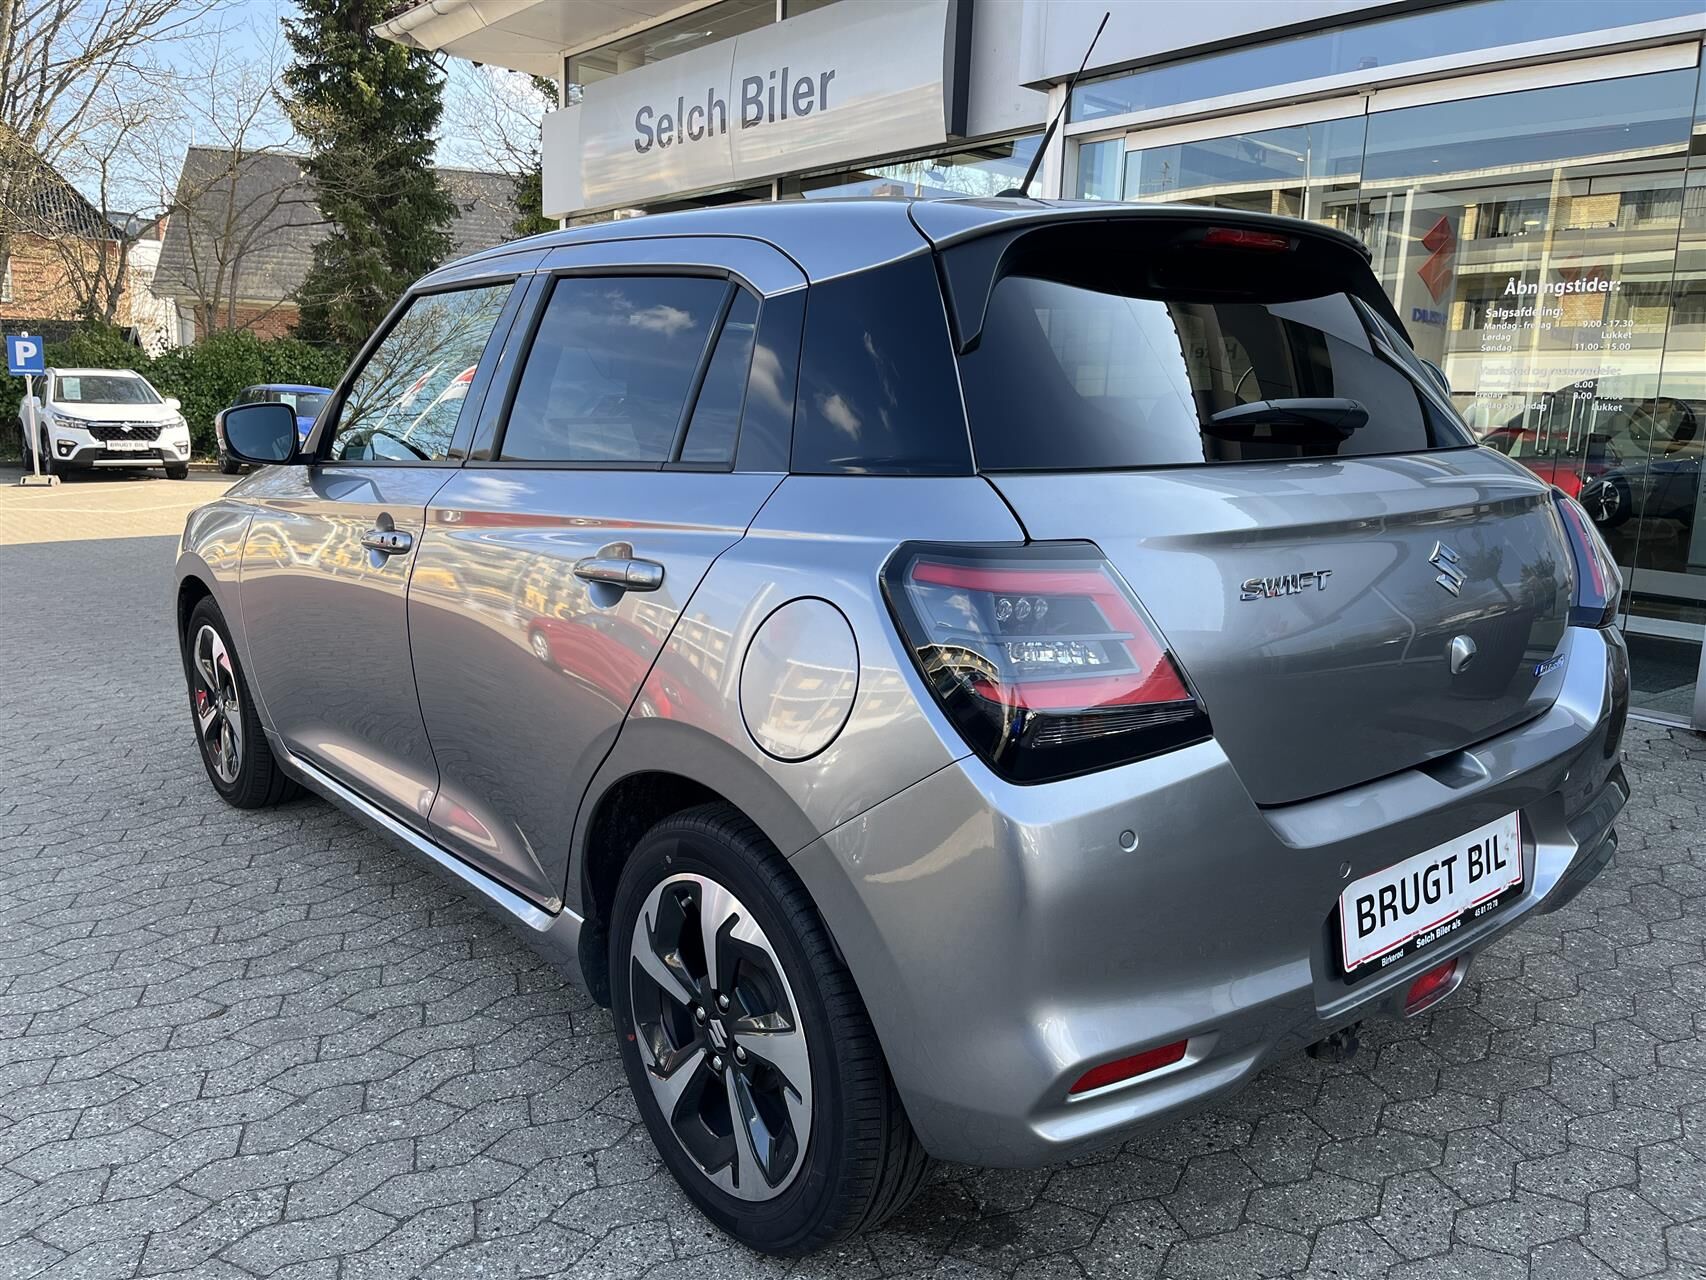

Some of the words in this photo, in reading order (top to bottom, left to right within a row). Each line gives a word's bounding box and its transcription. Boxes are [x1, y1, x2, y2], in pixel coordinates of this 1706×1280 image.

[635, 87, 727, 154] Selch
[741, 66, 836, 130] Biler
[1503, 276, 1622, 297] Åbnngstider:
[1485, 306, 1564, 320] Salgsafdeing:
[1483, 321, 1517, 332] Mandag
[1523, 320, 1552, 331] freag
[1582, 319, 1602, 329] 9.00
[1609, 319, 1634, 329] 17.30
[1601, 330, 1633, 340] Lukket
[15, 340, 37, 366] P
[1574, 342, 1599, 352] 11.00
[1606, 342, 1631, 352] 15.00
[1240, 569, 1333, 602] SWIFT
[1355, 854, 1458, 939] BRUGT
[1467, 834, 1507, 884] BIL
[1416, 930, 1436, 949] Selch
[1436, 923, 1451, 940] Biler
[1451, 918, 1462, 931] a/s
